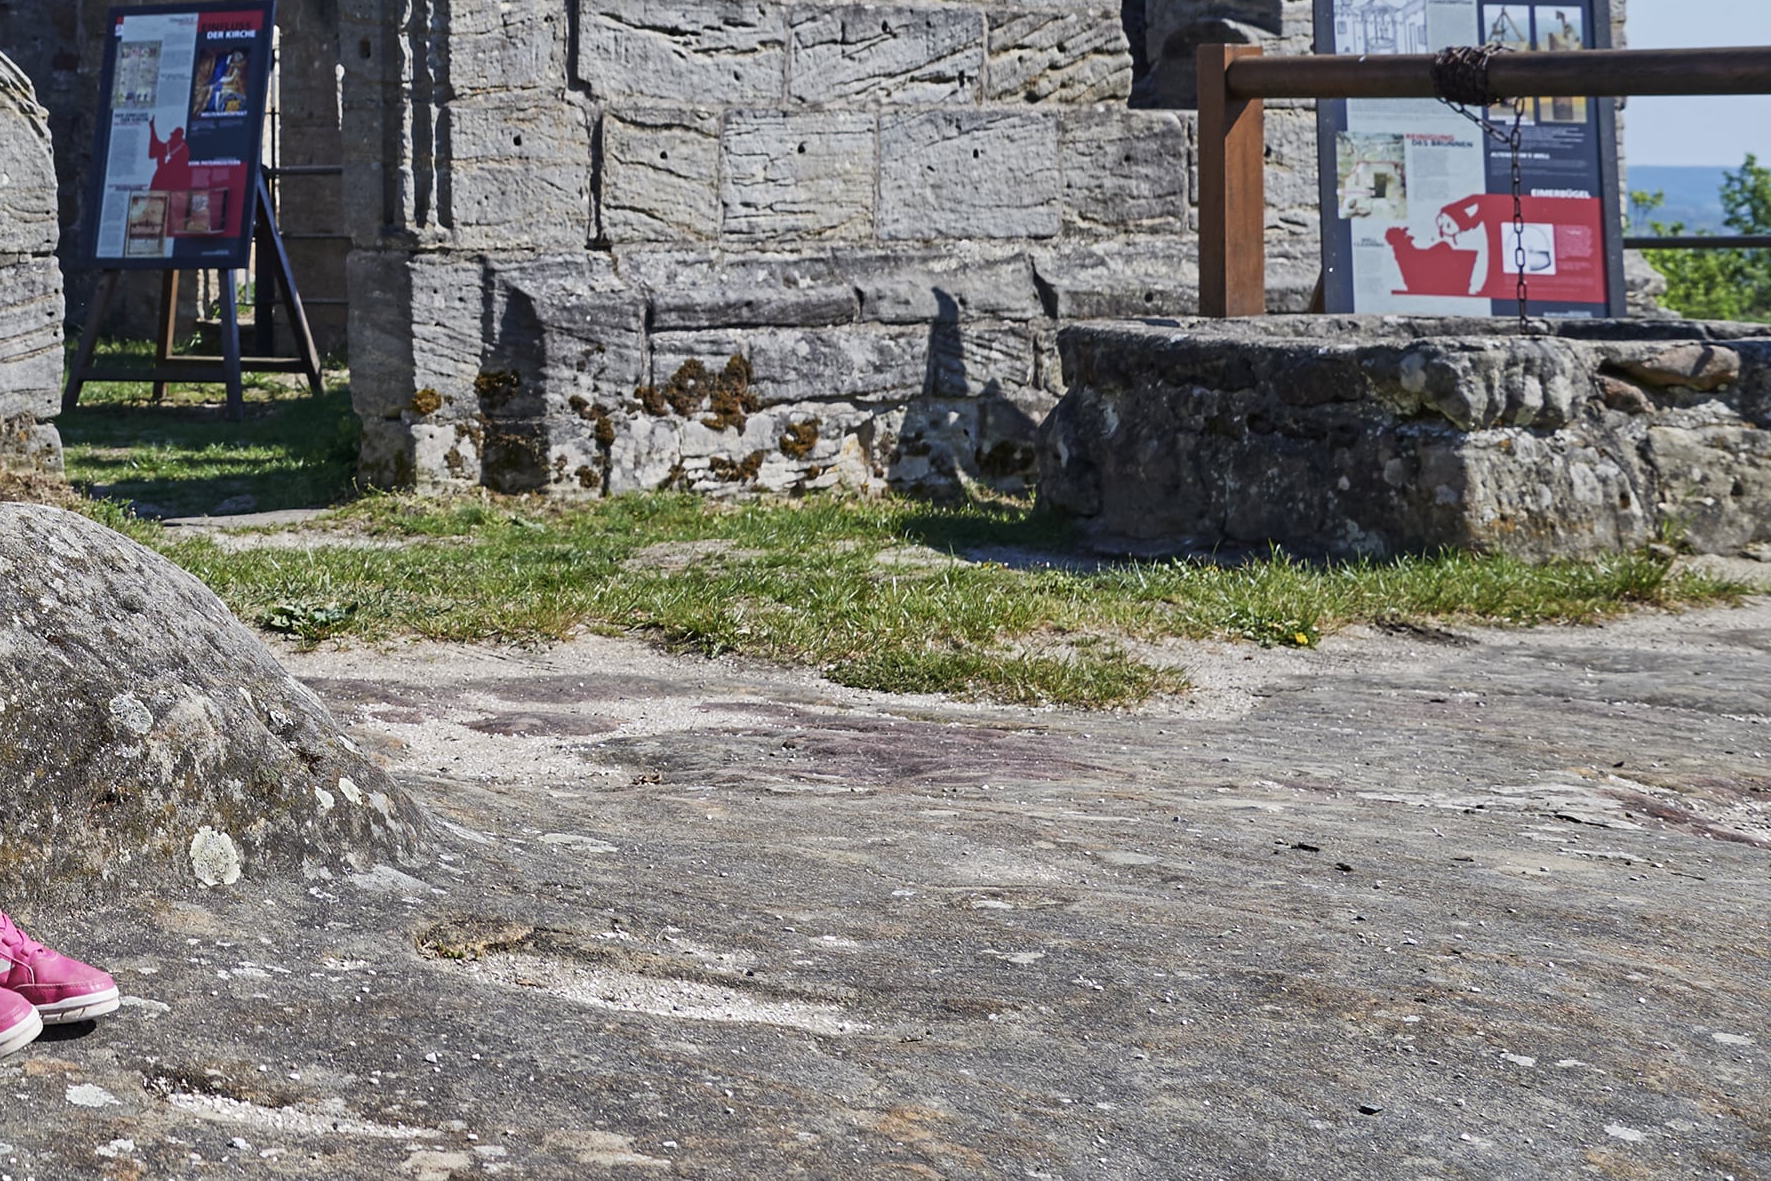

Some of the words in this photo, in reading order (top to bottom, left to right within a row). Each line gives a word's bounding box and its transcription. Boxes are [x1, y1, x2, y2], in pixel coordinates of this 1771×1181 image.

[207, 30, 224, 40] DER
[225, 29, 256, 39] KIRCHE
[1530, 188, 1592, 200] EIMERBÜGEL
